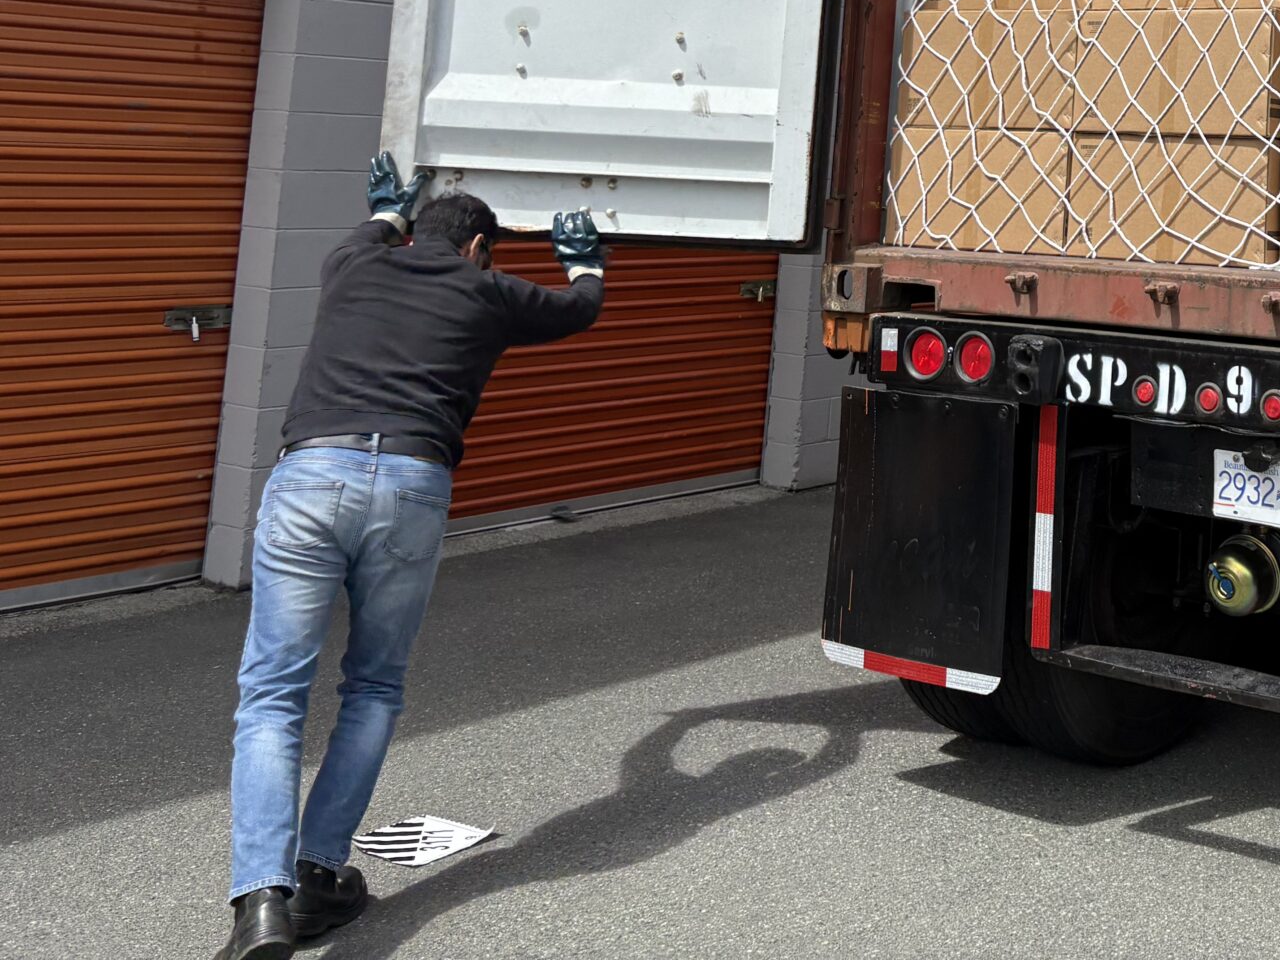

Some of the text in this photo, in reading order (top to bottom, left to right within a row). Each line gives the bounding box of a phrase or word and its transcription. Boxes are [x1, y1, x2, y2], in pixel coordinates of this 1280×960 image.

[1065, 353, 1127, 406] SP
[1226, 365, 1253, 415] 9
[1218, 470, 1276, 509] 2932
